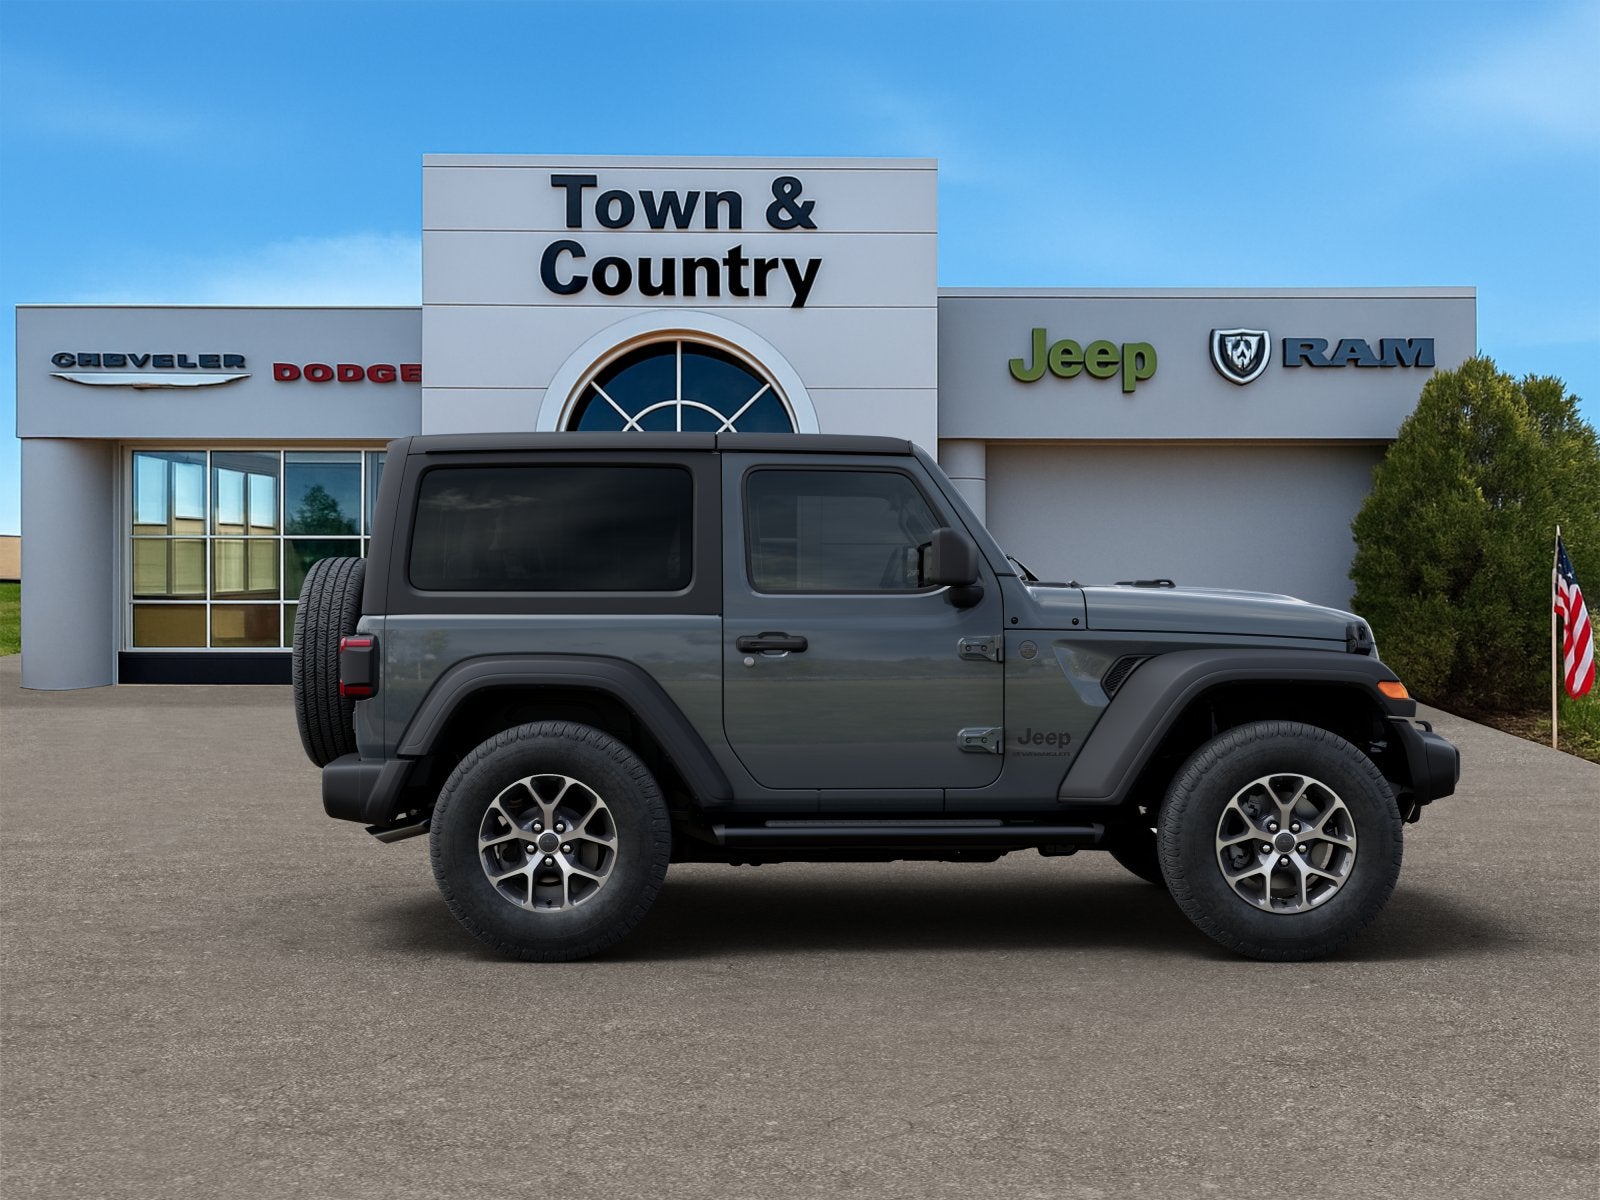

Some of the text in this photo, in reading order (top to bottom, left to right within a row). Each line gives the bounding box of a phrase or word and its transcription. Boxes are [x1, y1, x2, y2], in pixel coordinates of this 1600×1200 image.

[550, 174, 818, 230] Town &
[540, 239, 823, 308] Country
[273, 363, 422, 383] DODGE
[1009, 327, 1157, 393] Jeep
[1282, 337, 1436, 368] RAM
[1017, 727, 1071, 749] Jeep
